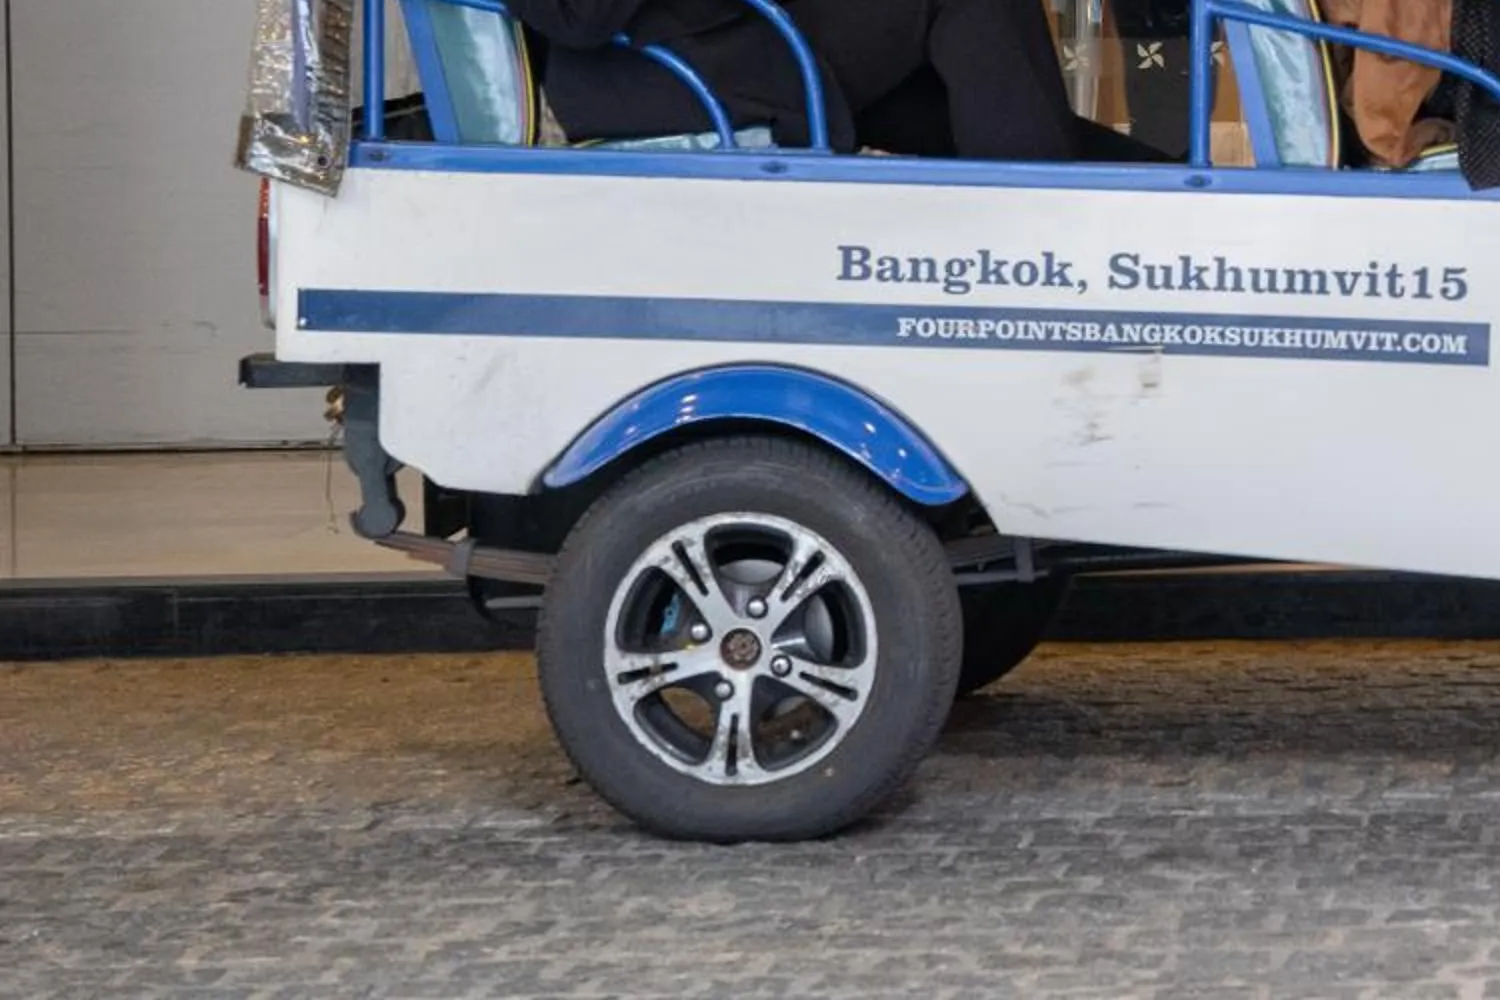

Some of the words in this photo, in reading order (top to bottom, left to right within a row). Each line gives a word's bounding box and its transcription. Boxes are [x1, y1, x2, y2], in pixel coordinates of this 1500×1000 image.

[837, 245, 1088, 294] Bangkok,
[1108, 252, 1468, 301] Sukhumvit15
[896, 316, 1468, 354] FOURPOINTSBANGKOKSUKHUMVIT.COM
